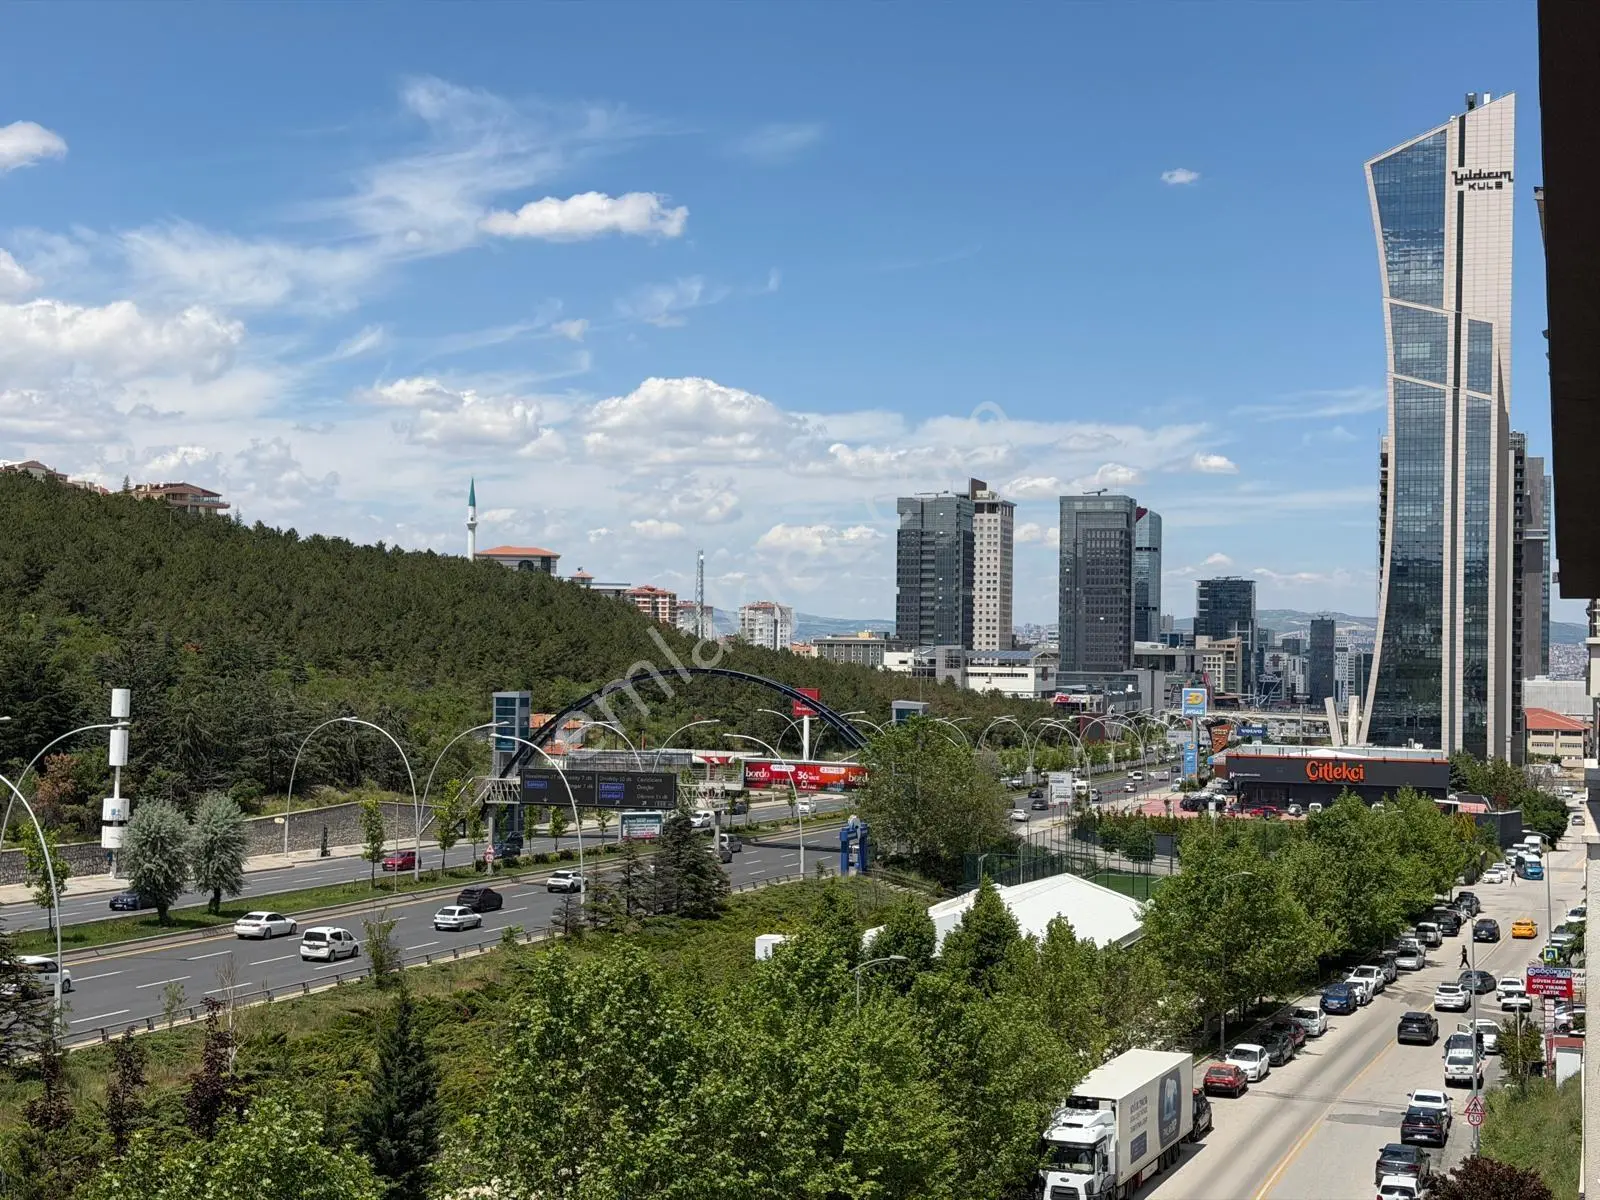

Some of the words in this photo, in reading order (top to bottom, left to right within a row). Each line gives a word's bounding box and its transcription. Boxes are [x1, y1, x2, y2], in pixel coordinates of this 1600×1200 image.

[1468, 181, 1503, 190] KULE
[745, 767, 770, 778] bordo
[797, 771, 809, 780] 36
[1470, 1114, 1481, 1123] 30
